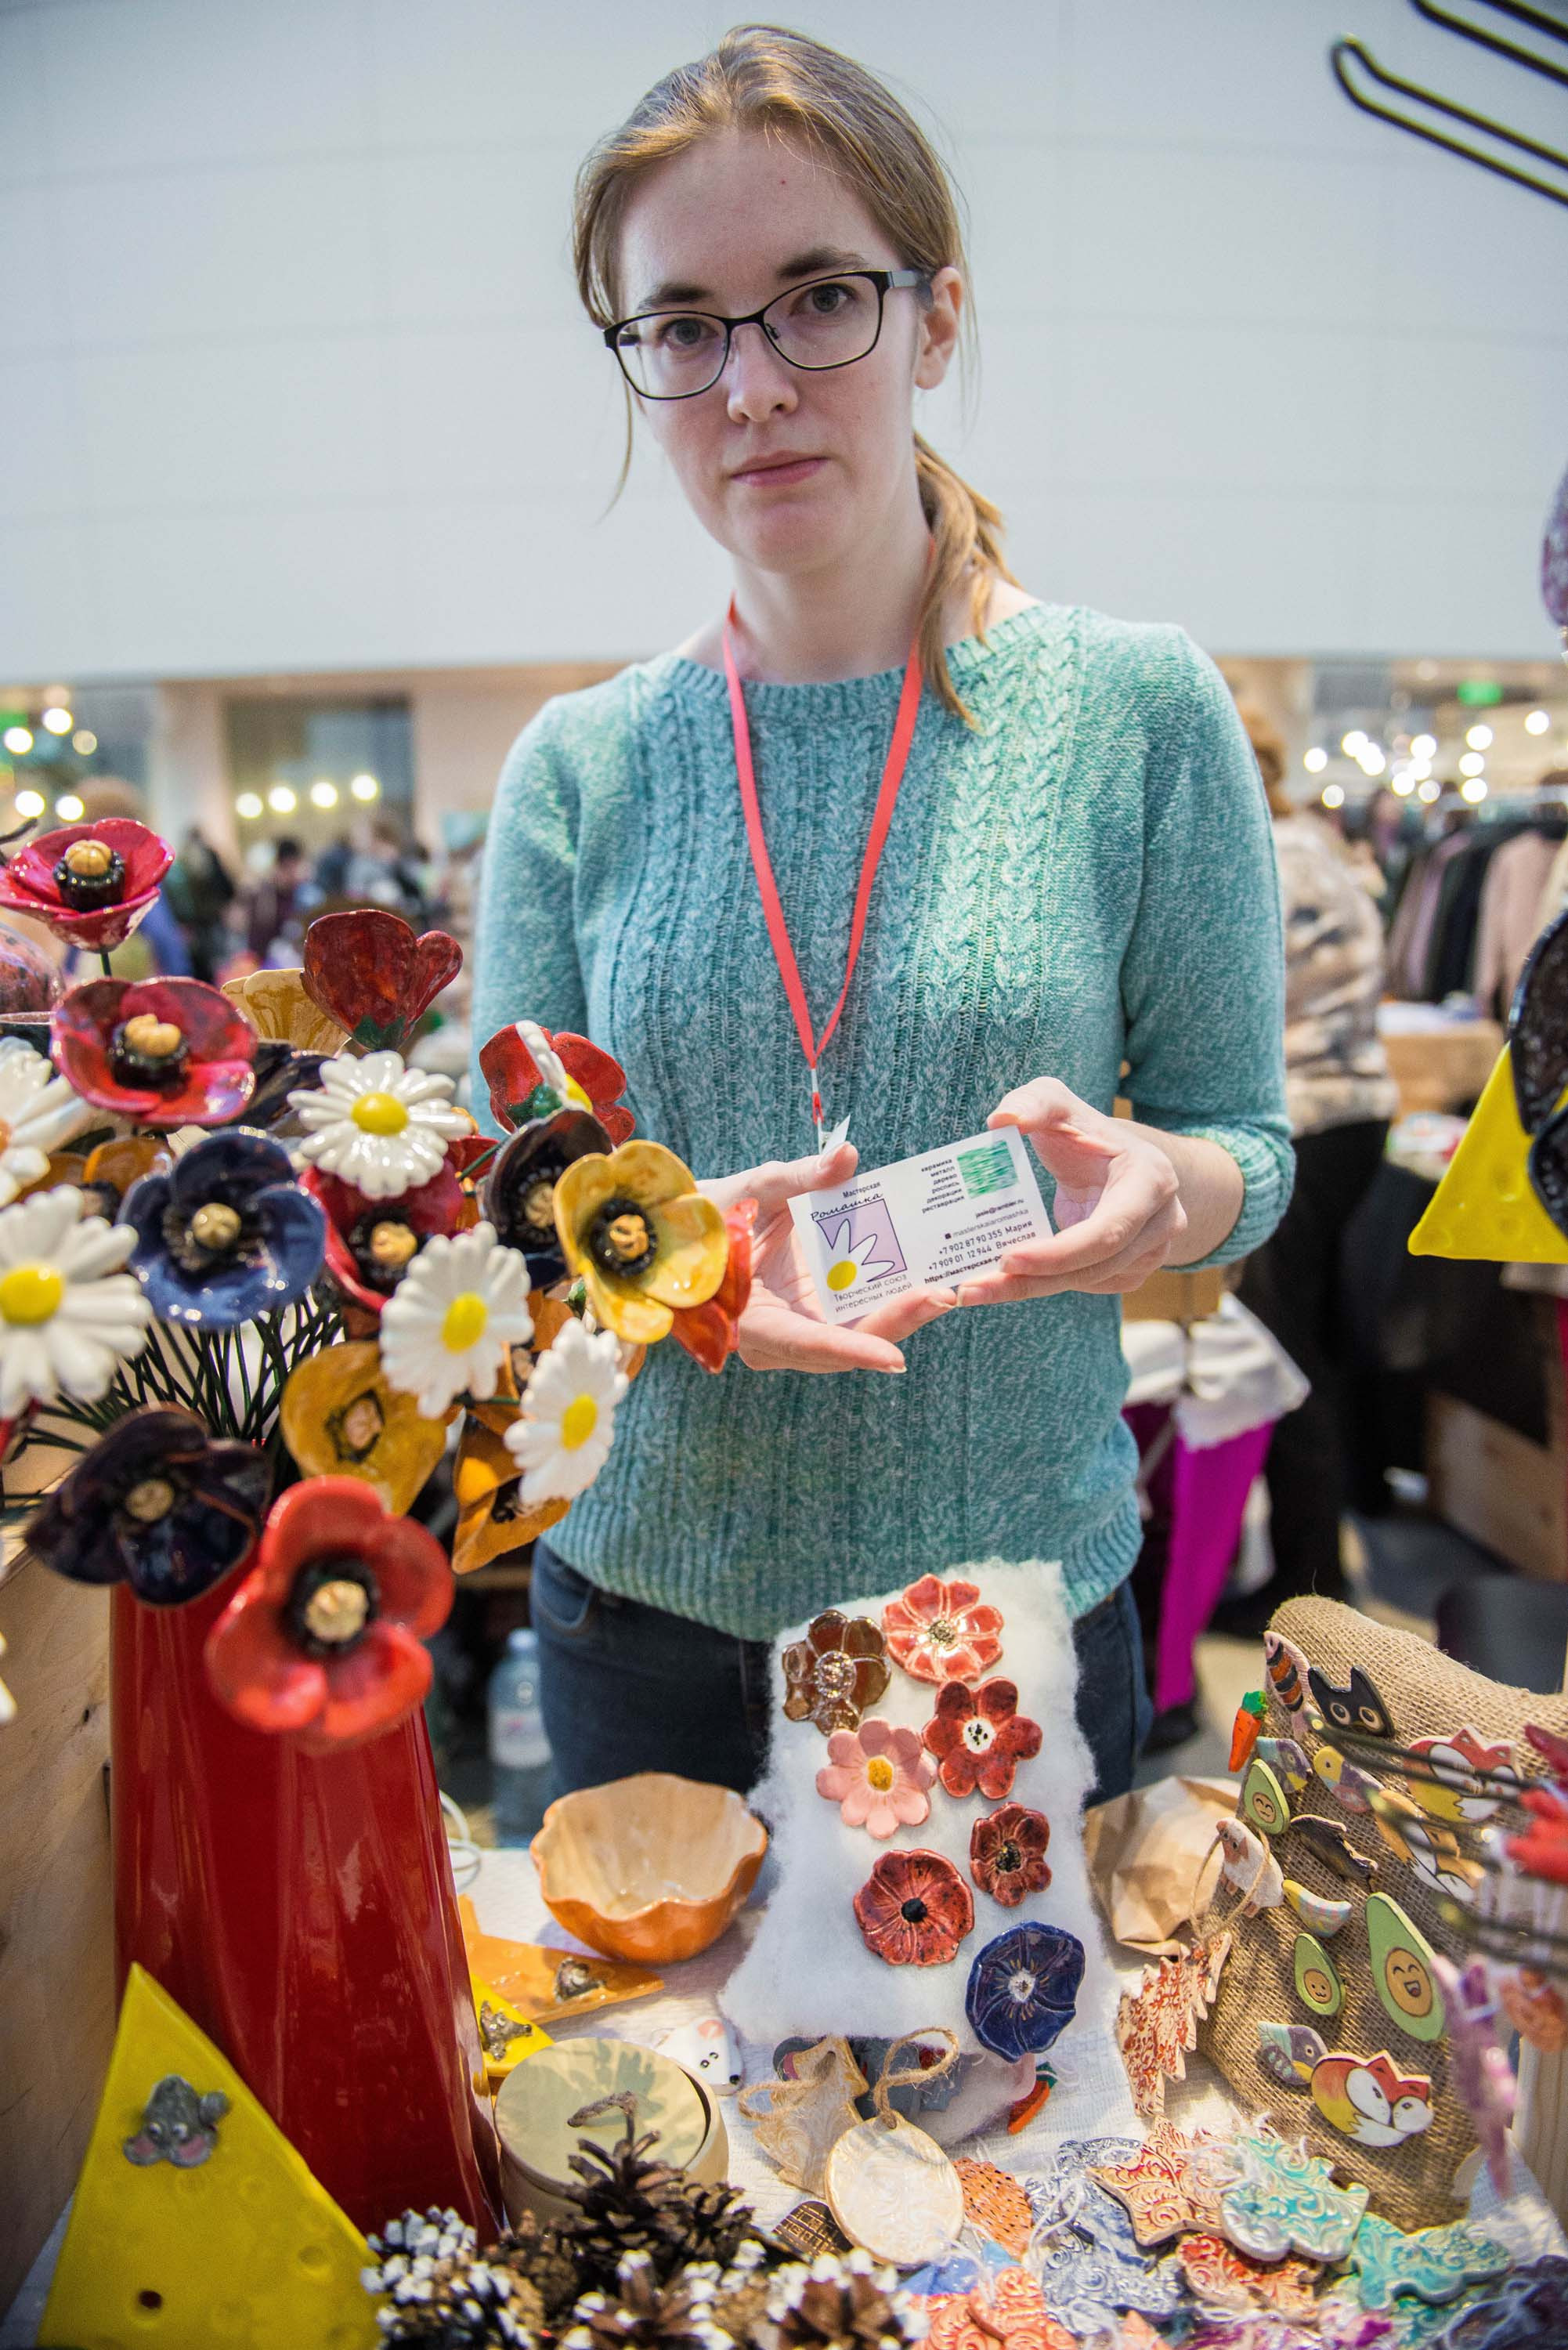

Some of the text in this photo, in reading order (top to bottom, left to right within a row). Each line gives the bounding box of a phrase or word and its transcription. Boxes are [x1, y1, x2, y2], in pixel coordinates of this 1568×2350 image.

[843, 1181, 881, 1198] Мастерская
[932, 1182, 959, 1194] роспись
[934, 1173, 957, 1185] дерево
[810, 1193, 883, 1221] Ромашка
[939, 1257, 953, 1267] 909
[955, 1254, 964, 1264] 01
[967, 1250, 976, 1259] 12
[976, 1246, 992, 1256] 944
[995, 1232, 1036, 1249] Вячеслав
[948, 1242, 964, 1253] 902
[965, 1238, 974, 1247] 87
[976, 1235, 987, 1244] 90
[988, 1229, 1003, 1240] 355
[1005, 1220, 1032, 1235] Мария
[834, 1274, 907, 1302] Творческий союз
[835, 1282, 912, 1313] интересных людей
